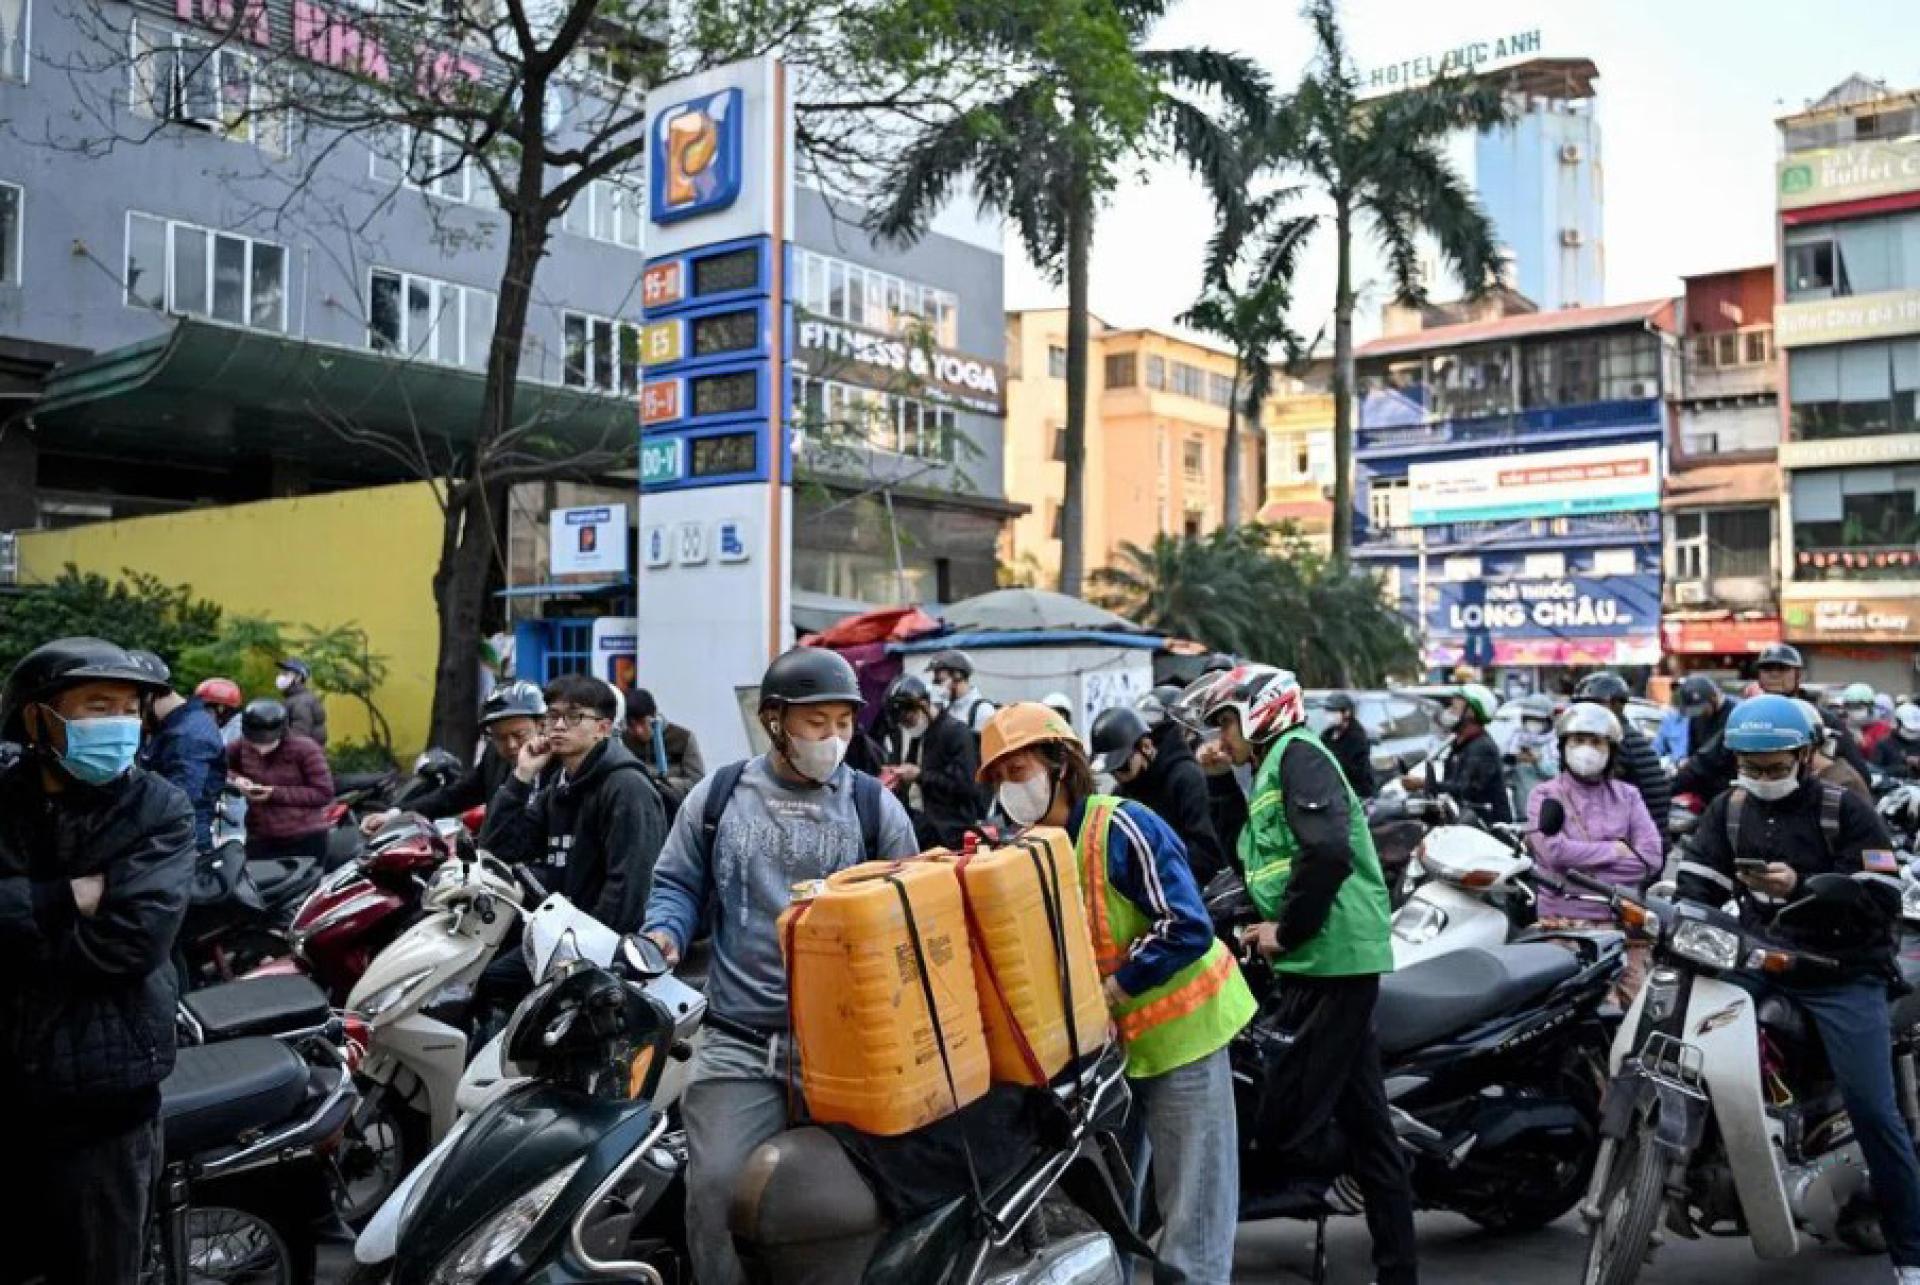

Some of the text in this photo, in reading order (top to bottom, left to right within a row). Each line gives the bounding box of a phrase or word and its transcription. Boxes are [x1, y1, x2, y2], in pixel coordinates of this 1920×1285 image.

[1371, 56, 1434, 88] HOTEL
[1495, 29, 1541, 59] ANH
[651, 326, 670, 357] E5
[800, 322, 905, 371] FITNESS
[908, 346, 929, 376] &
[932, 352, 998, 394] YOGA
[1450, 594, 1616, 630] LONG CHÂU
